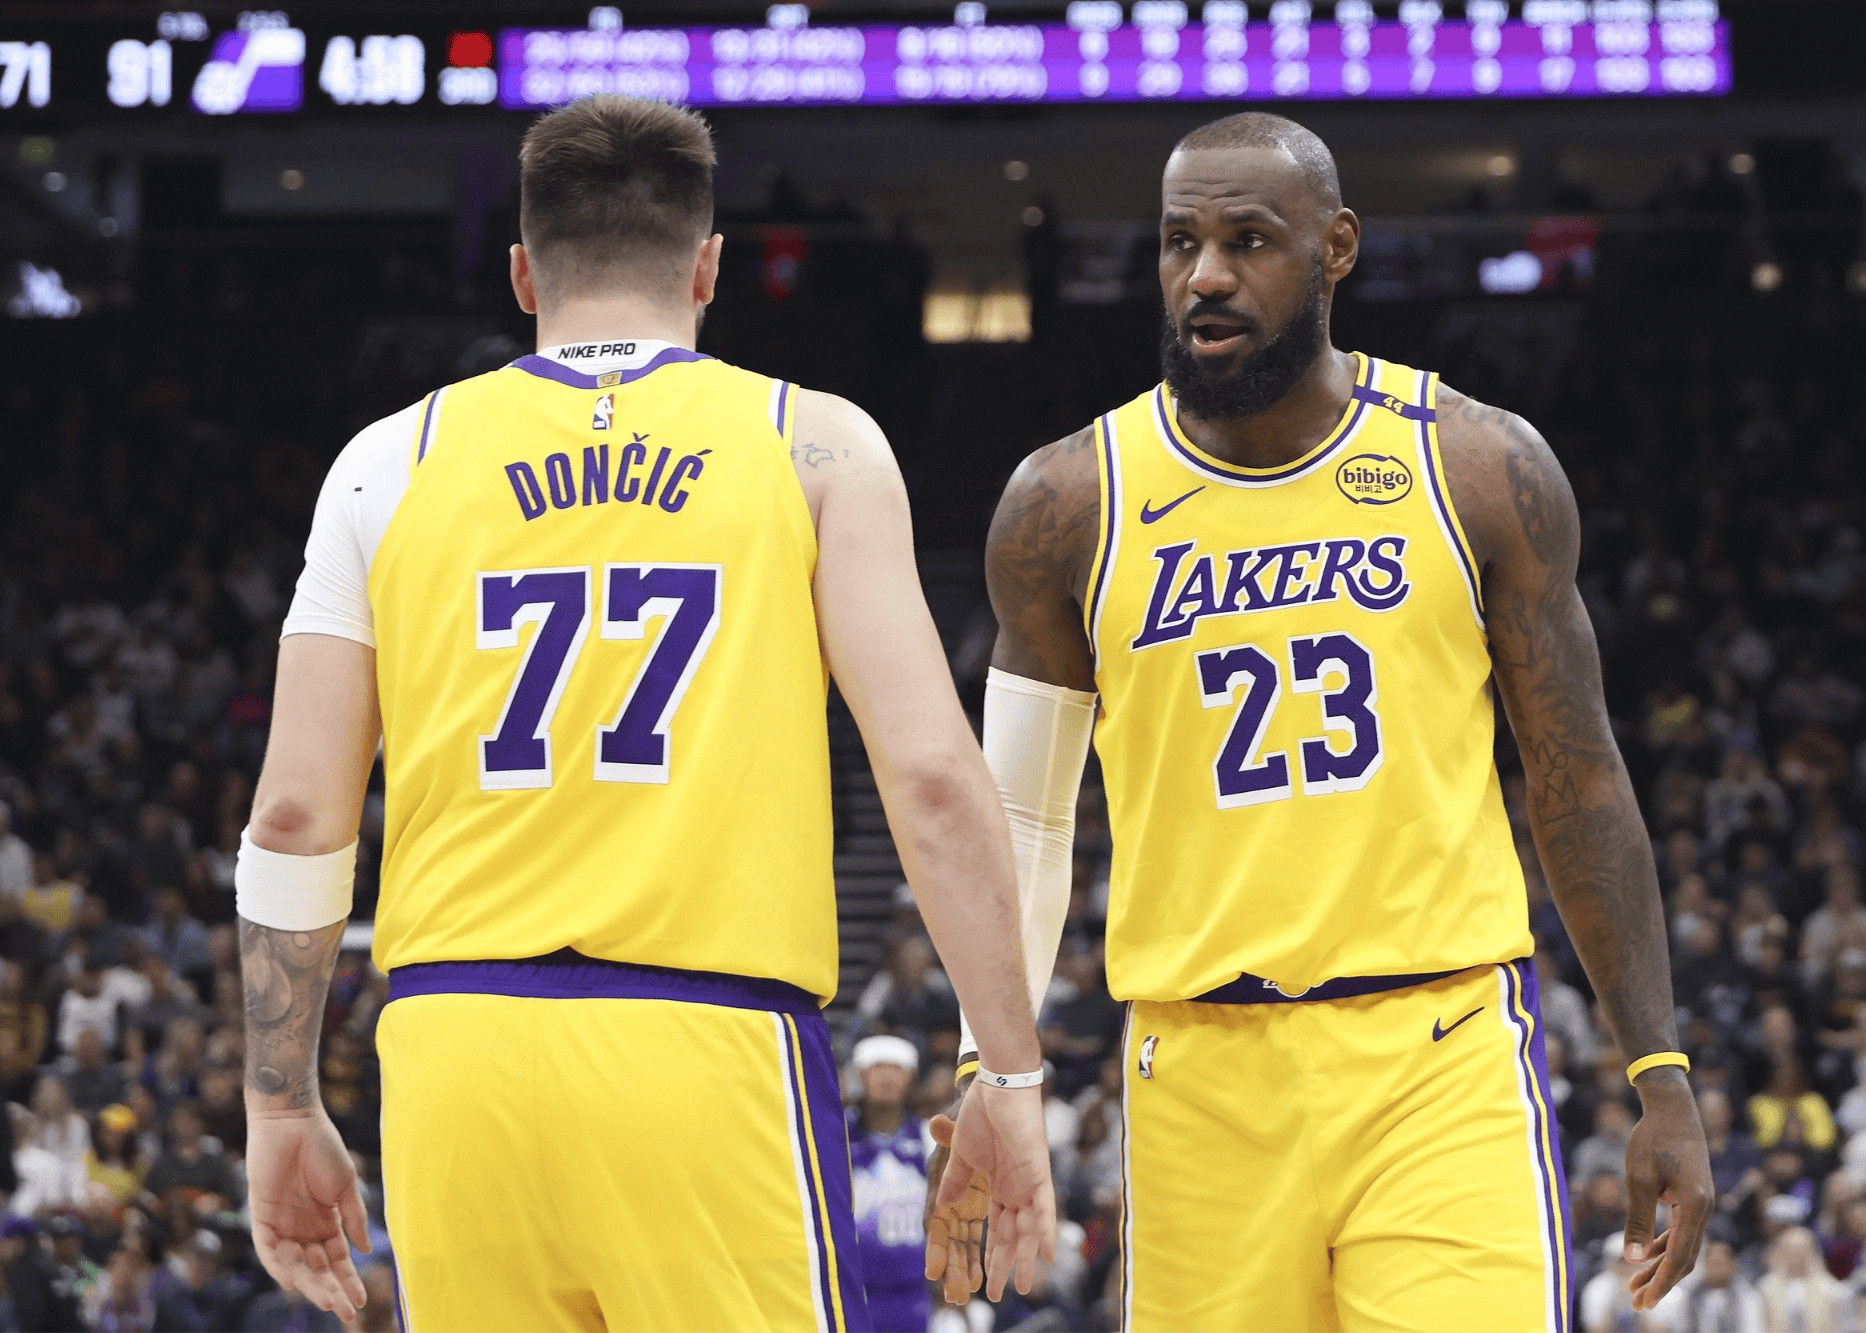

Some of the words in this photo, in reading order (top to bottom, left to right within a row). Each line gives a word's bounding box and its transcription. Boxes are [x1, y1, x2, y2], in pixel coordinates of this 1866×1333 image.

[557, 345, 597, 359] NIKE
[599, 342, 636, 357] PRO
[1382, 396, 1405, 414] 44
[504, 432, 713, 521] DONČIĆ
[1343, 467, 1408, 490] bibigo
[1355, 484, 1383, 494] 비비고
[1130, 536, 1412, 654] LAKERS
[474, 562, 723, 790] 77
[1193, 631, 1385, 810] 23
